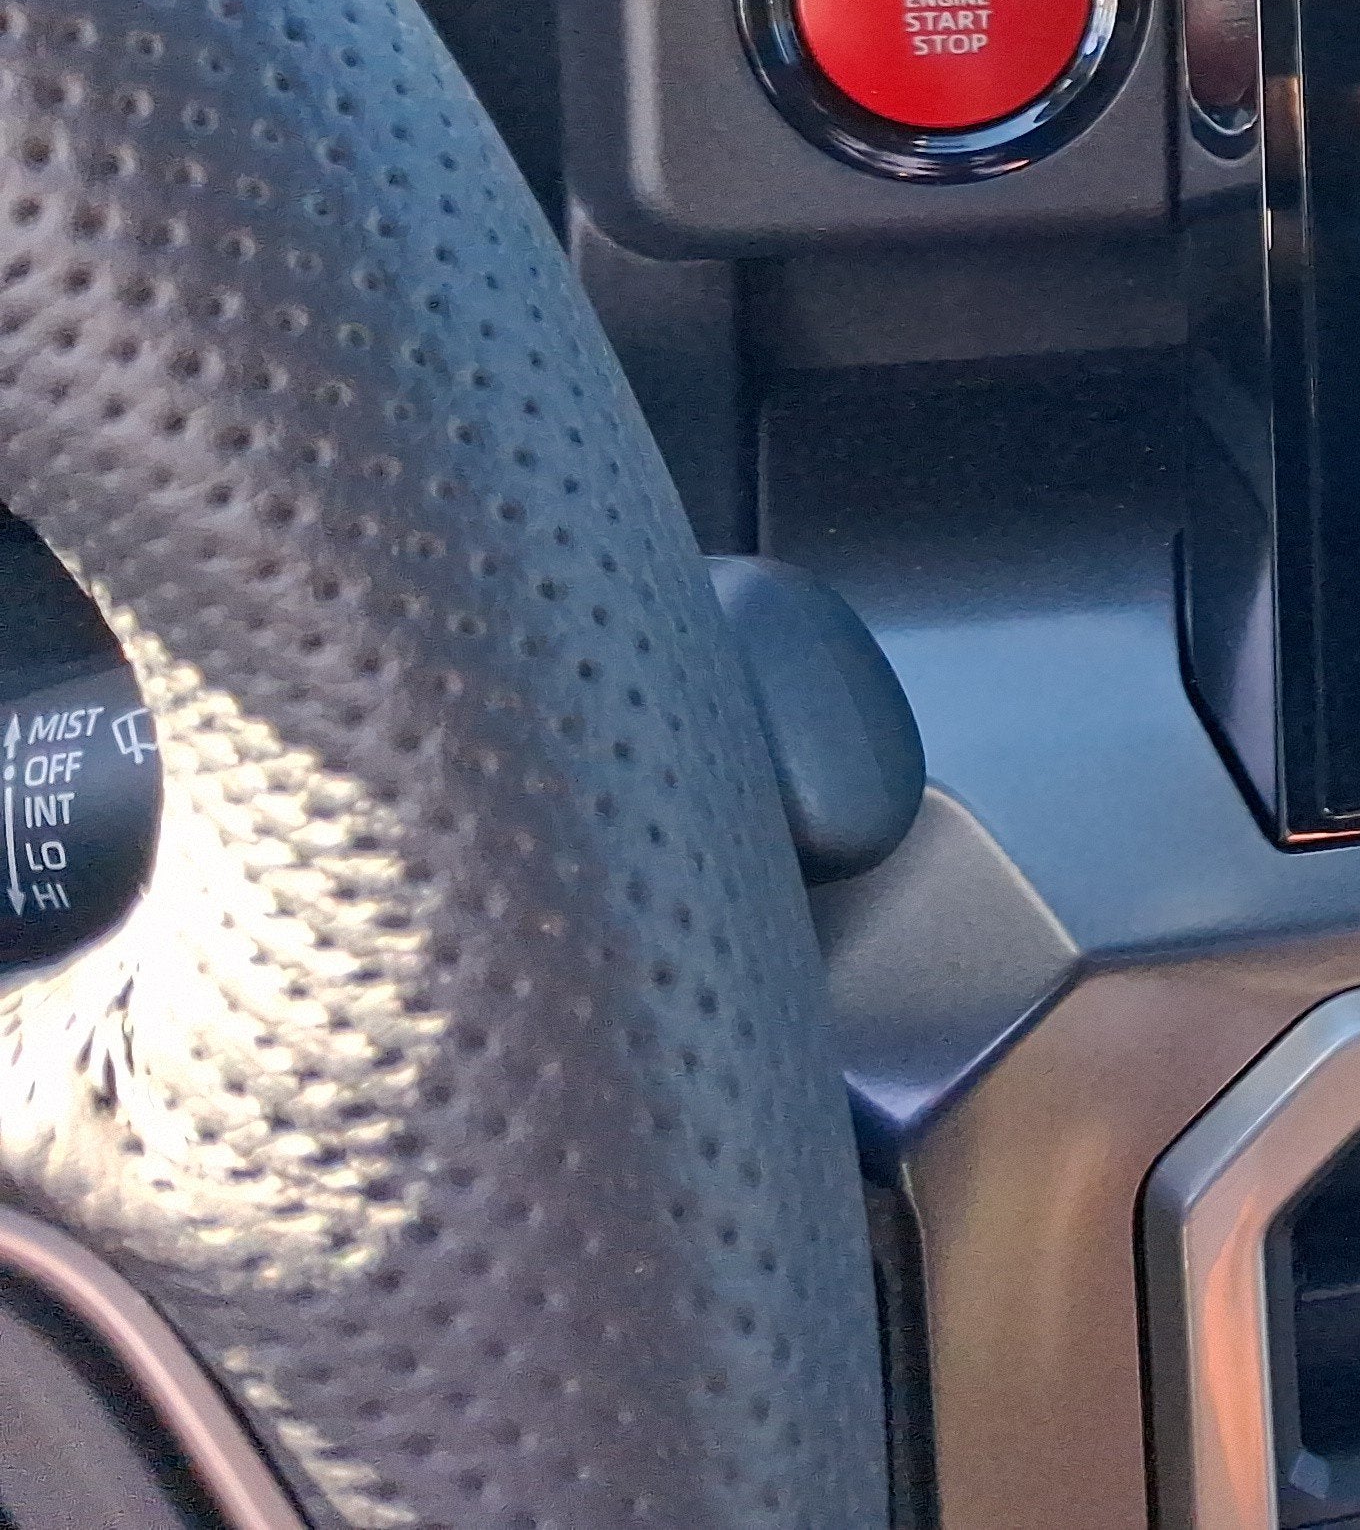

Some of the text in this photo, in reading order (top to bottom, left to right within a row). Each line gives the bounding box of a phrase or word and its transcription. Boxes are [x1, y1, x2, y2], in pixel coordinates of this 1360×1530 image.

[905, 10, 993, 33] START
[913, 34, 989, 56] STOP
[27, 706, 105, 745] MIST
[24, 751, 84, 787] OFF
[24, 791, 76, 829] INT
[25, 840, 67, 871] LO
[32, 883, 71, 910] HI
